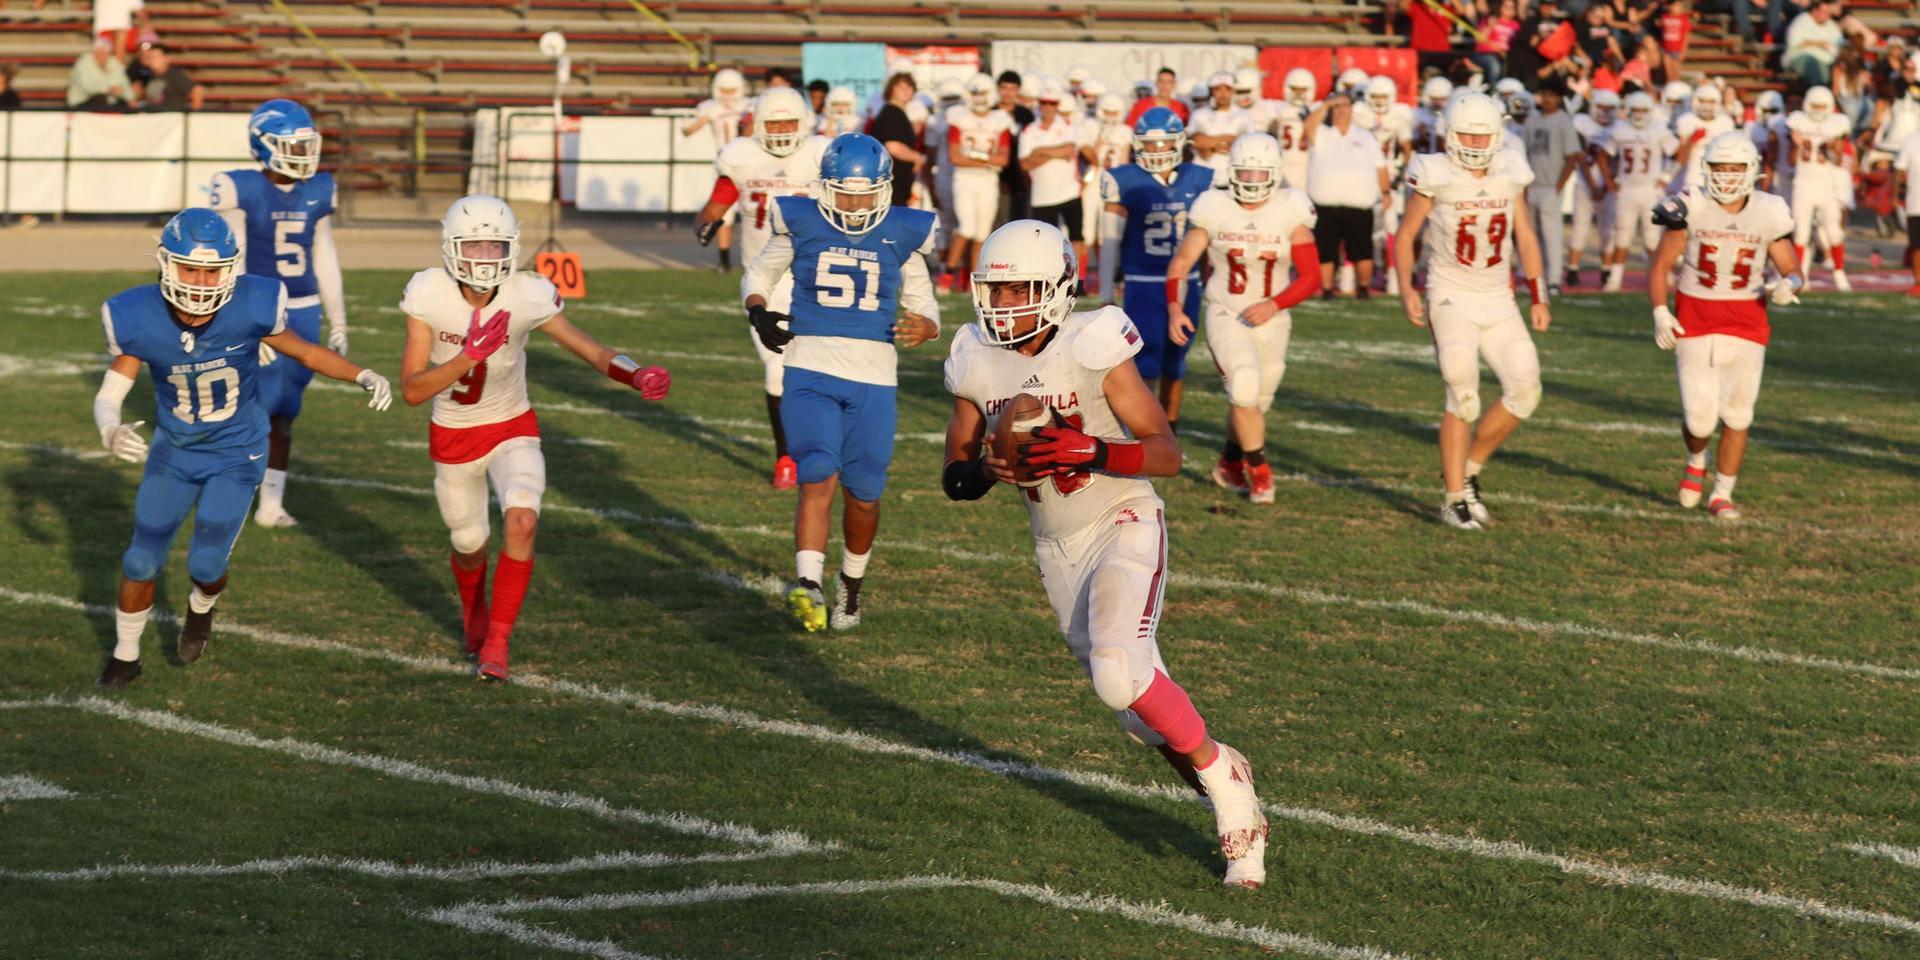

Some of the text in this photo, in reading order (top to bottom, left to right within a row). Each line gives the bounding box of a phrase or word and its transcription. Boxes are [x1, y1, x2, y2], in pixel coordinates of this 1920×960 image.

[1624, 147, 1650, 174] 53
[274, 220, 307, 277] 5
[829, 246, 878, 261] BLUE RAIDERS
[1143, 211, 1190, 256] 21
[1217, 231, 1281, 244] CHOWCHILLA
[1455, 212, 1508, 268] 69
[543, 257, 578, 289] 20
[814, 251, 881, 312] 51
[990, 262, 1009, 270] Riddell
[1698, 242, 1756, 290] 55
[171, 357, 227, 374] BLUE RAIDERS
[450, 360, 488, 405] 9
[166, 366, 241, 425] 10
